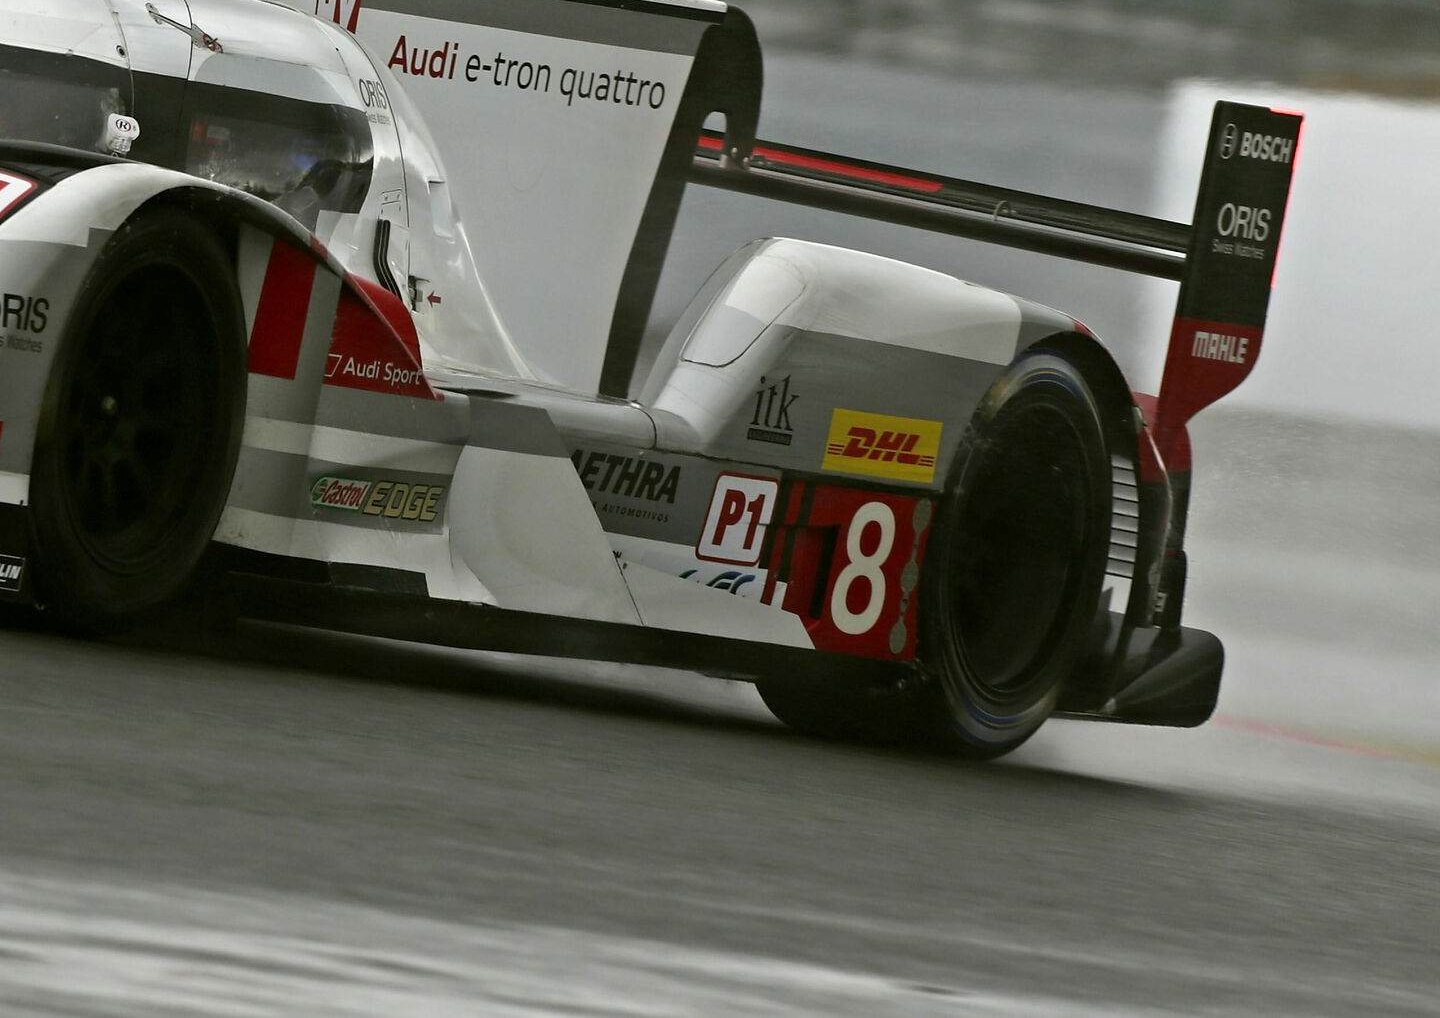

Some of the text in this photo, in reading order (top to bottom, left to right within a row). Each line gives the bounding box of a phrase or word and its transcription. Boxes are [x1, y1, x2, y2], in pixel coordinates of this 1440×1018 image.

[388, 35, 666, 109] Audi e-tron quattro
[359, 79, 387, 110] ORIS
[1240, 131, 1294, 164] BOSCH
[1217, 202, 1271, 241] ORIS
[1191, 331, 1249, 364] MAHLE
[343, 358, 423, 386] Audi Sport
[750, 374, 800, 431] itk
[841, 427, 921, 465] DHL
[322, 481, 445, 522] Castrol EDGE
[602, 503, 669, 523] AUTOMOTIVOS
[711, 489, 766, 550] P1
[831, 501, 896, 635] 8
